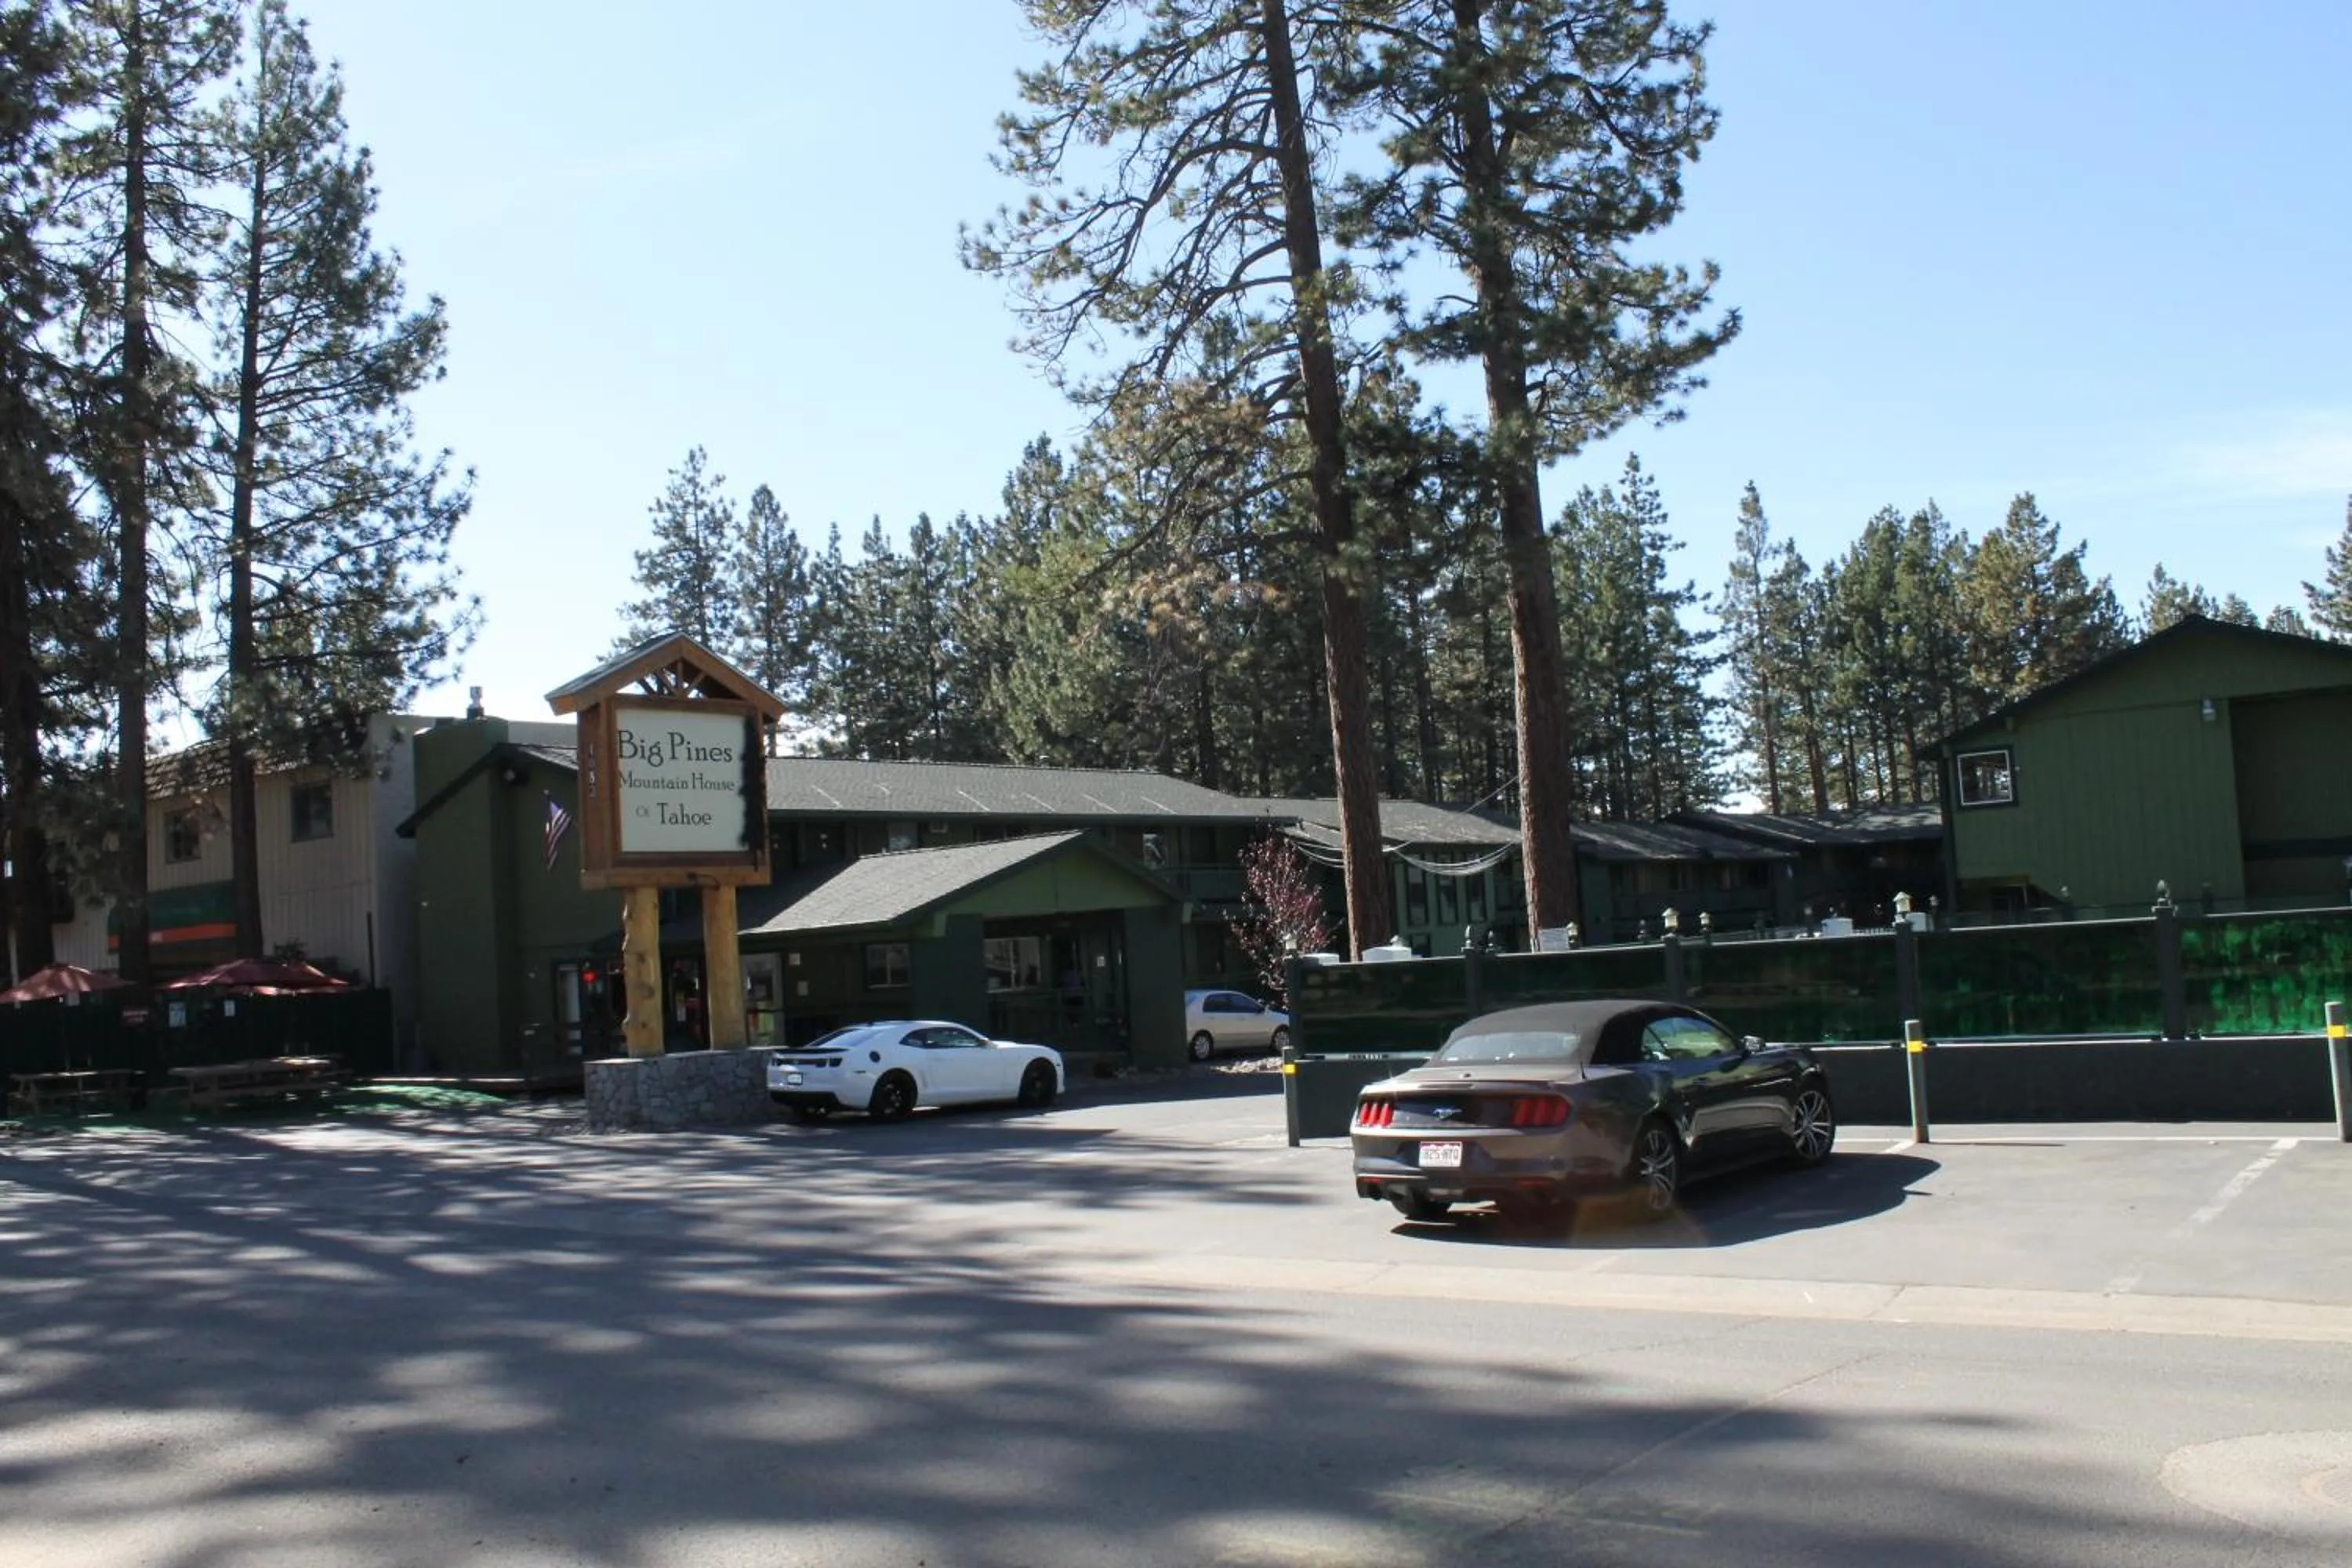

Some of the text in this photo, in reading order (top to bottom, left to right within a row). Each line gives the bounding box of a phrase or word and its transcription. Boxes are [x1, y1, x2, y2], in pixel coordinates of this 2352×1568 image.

[618, 730, 733, 767] Big Pines
[618, 770, 735, 791] Mountain House
[657, 803, 712, 826] Tahoe
